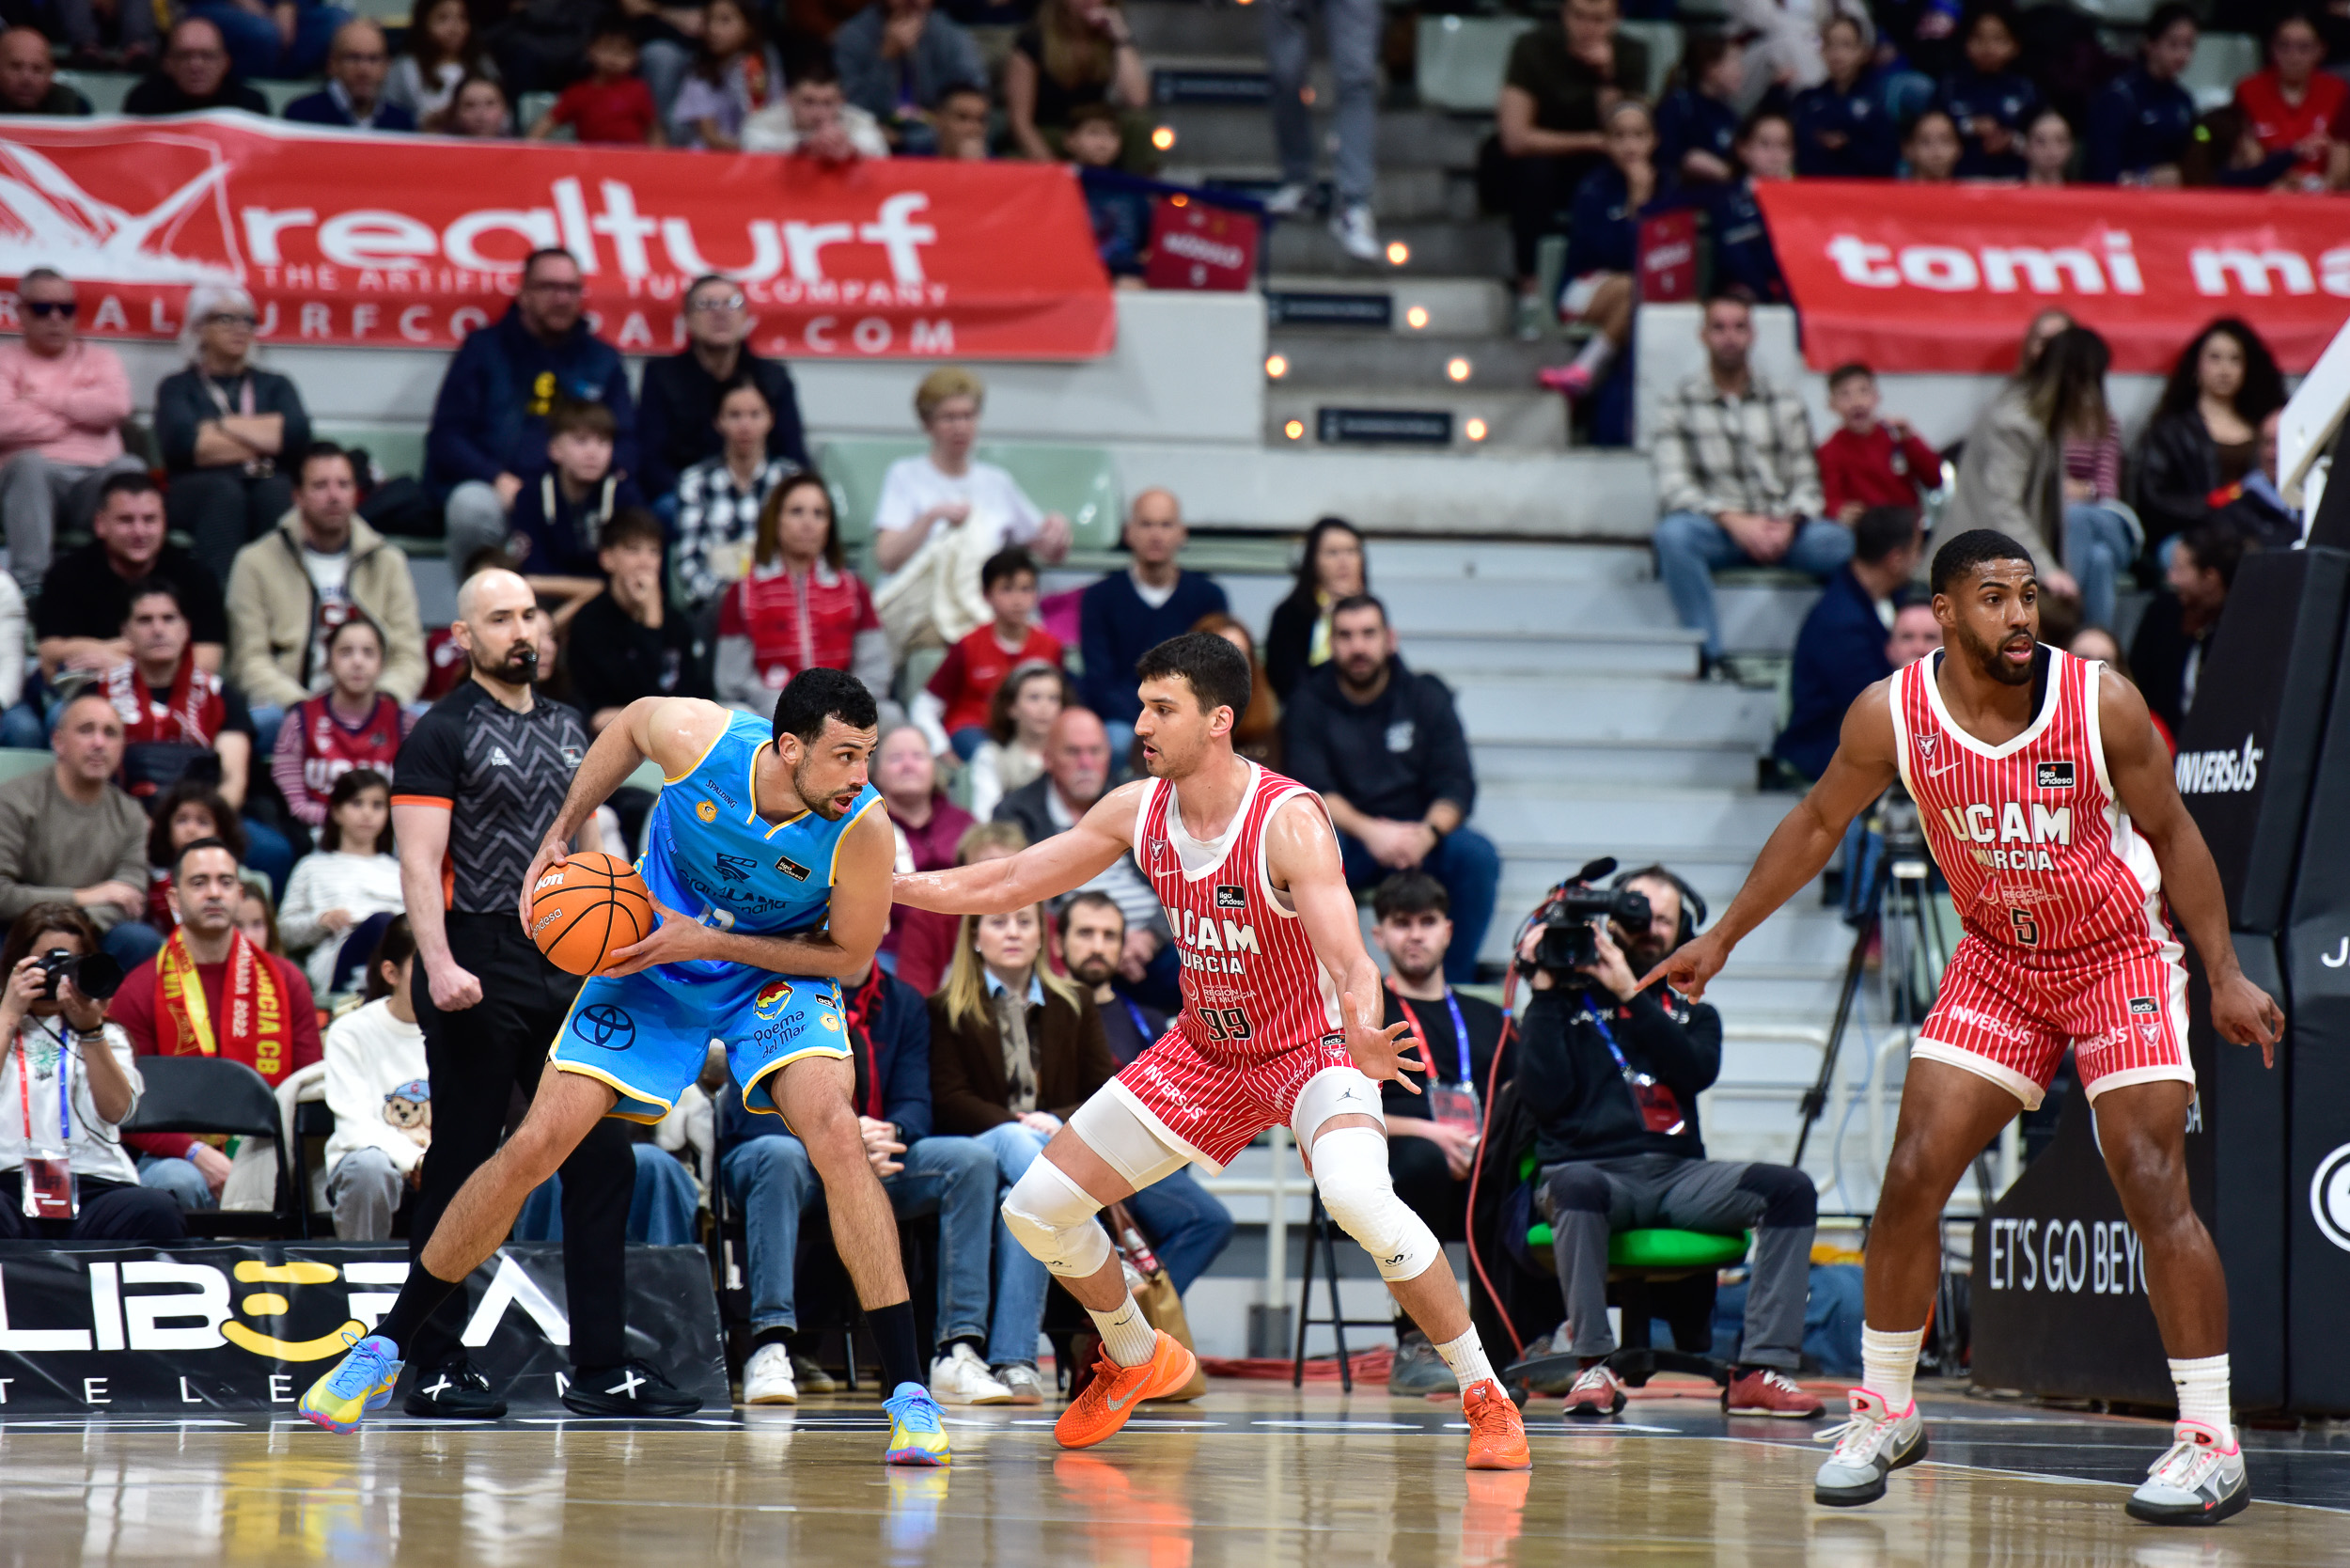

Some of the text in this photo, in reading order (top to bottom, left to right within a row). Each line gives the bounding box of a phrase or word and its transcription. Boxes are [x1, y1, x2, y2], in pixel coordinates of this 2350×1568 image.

[242, 176, 936, 282] realturf
[1827, 229, 2145, 294] tomi
[263, 268, 338, 290] THE
[356, 270, 590, 299] ARTIFIC
[745, 279, 948, 306] COMPANY
[2040, 770, 2056, 778] liga
[2040, 776, 2073, 785] endesa
[705, 779, 738, 808] SPALDING
[1940, 802, 2071, 846] UCAM
[777, 865, 805, 881] endesa
[779, 861, 792, 871] liga
[1969, 849, 2055, 871] MURCIA
[1219, 898, 1245, 906] endesa
[1163, 905, 1261, 955] UCAM
[2010, 906, 2039, 946] 5
[817, 996, 835, 1008] acb
[1203, 987, 1239, 996] REGIÓN
[1219, 989, 1257, 1003] MURCIA
[2132, 1002, 2154, 1013] acb
[232, 998, 249, 1038] 2022
[753, 1011, 806, 1047] Poema
[1198, 1007, 1253, 1041] 99
[1570, 1008, 1615, 1026] JAK
[1949, 1005, 2032, 1047] INVERSUS
[256, 1039, 281, 1075] CB
[762, 1024, 807, 1059] del Mar
[1324, 1037, 1341, 1046] acb
[1143, 1063, 1207, 1121] INVERSUS
[2043, 1218, 2087, 1294] GO
[2093, 1221, 2150, 1295] BEY
